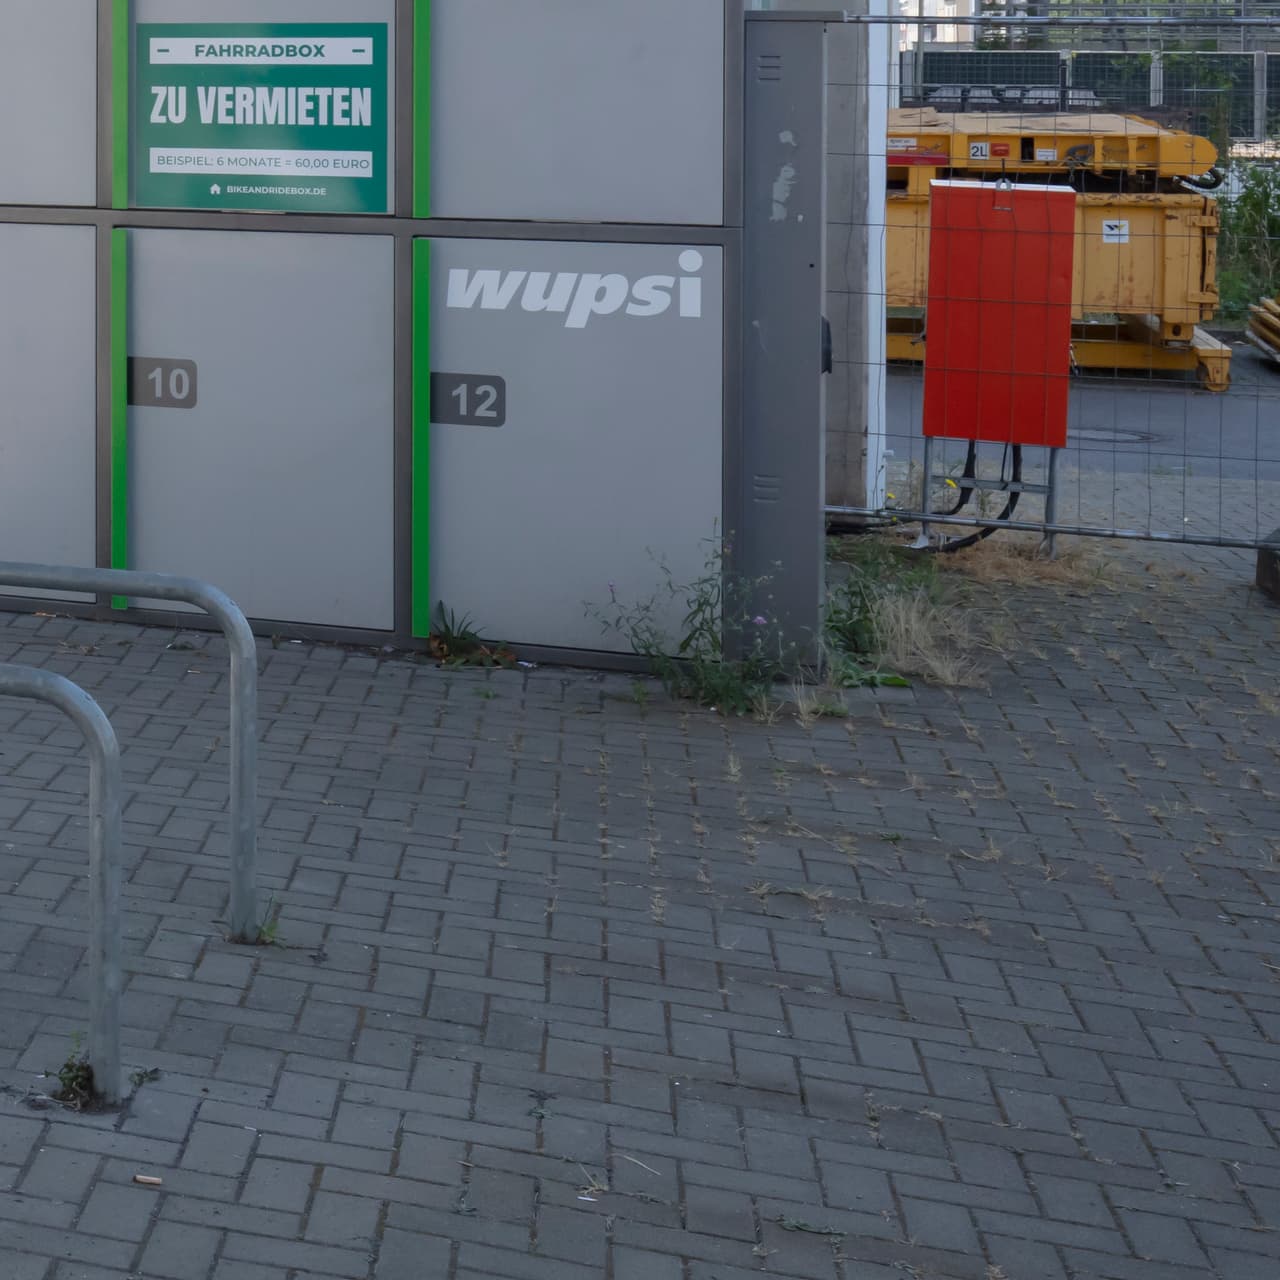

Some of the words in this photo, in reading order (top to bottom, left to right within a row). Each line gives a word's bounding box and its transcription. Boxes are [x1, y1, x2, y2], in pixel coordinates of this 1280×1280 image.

[194, 44, 325, 58] FAHRRADBOX
[150, 86, 187, 124] ZU
[197, 86, 372, 126] VERMIETEN
[157, 155, 213, 167] BEISPIEL:
[216, 157, 224, 167] 6
[227, 157, 281, 168] MONATE
[295, 158, 329, 170] 60,00
[333, 159, 370, 169] EURO
[226, 185, 327, 196] BIKEANDRIDEBOX.DE
[446, 249, 703, 328] wupsi
[147, 366, 190, 400] 10
[452, 383, 498, 418] 12
